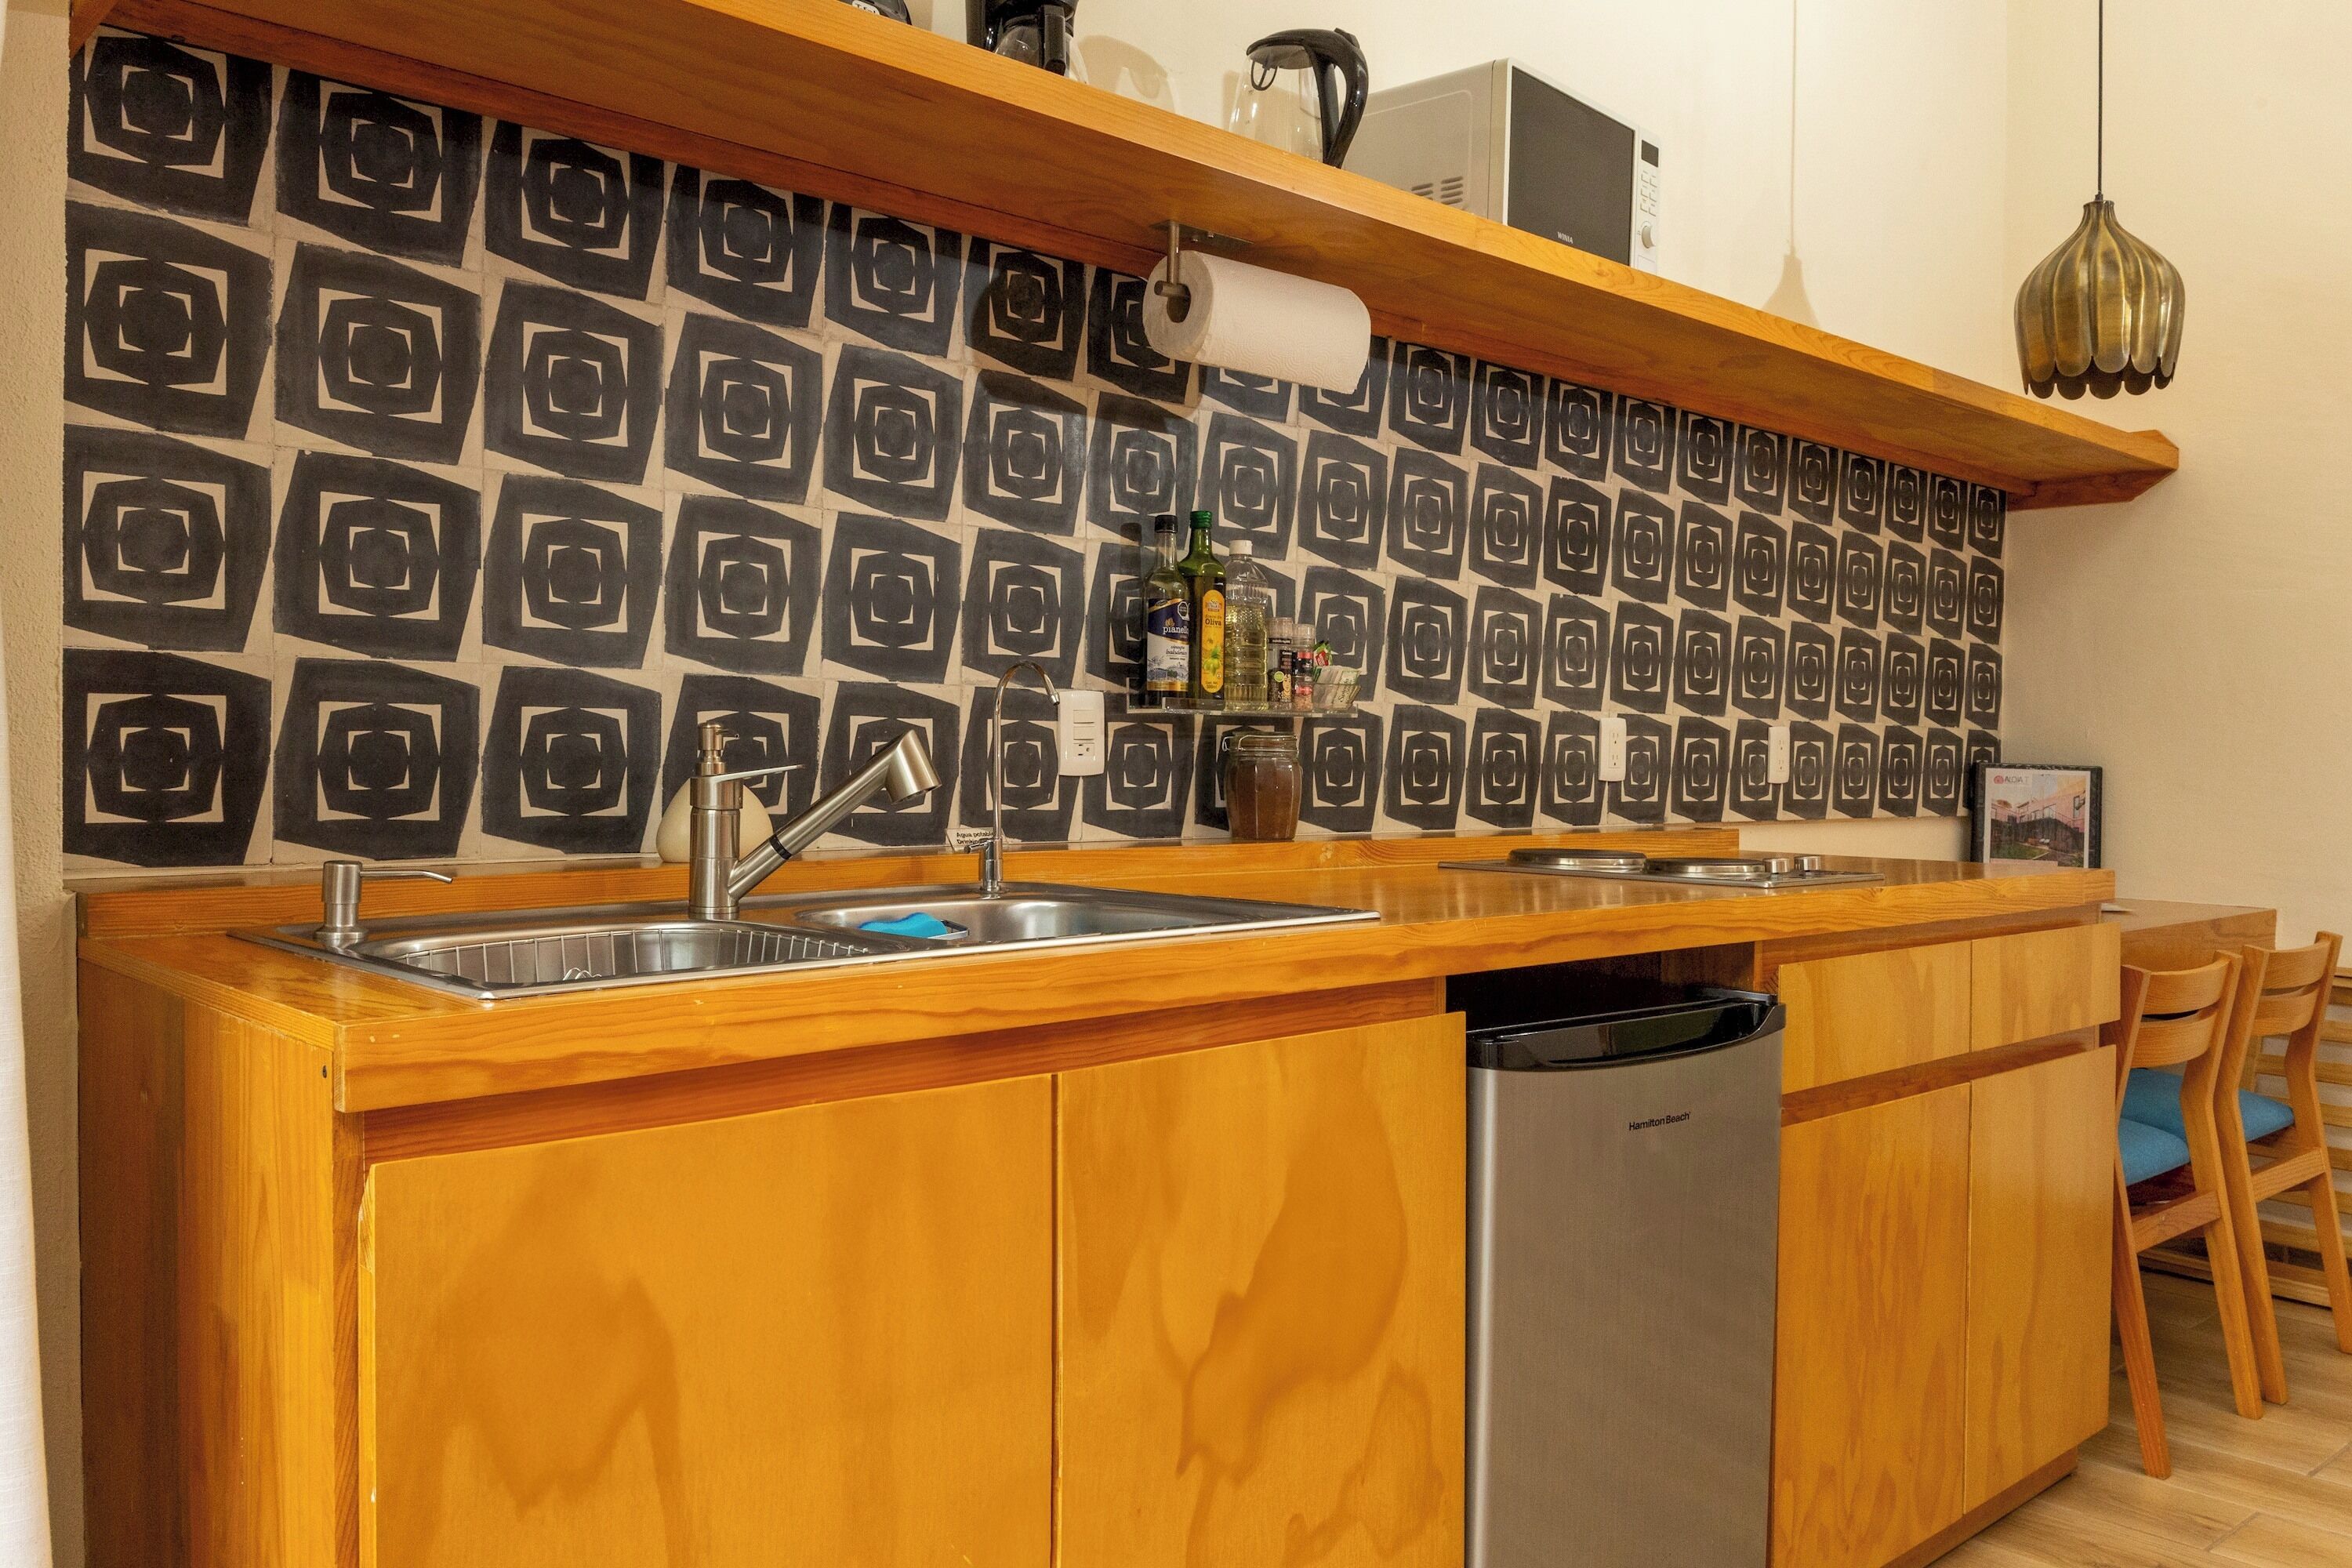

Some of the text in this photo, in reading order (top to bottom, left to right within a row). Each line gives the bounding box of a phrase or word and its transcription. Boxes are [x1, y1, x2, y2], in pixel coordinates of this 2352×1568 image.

[1557, 231, 1573, 244] WINIA
[1205, 618, 1222, 626] Oliva
[1629, 1112, 1690, 1131] Hamilton Beach
